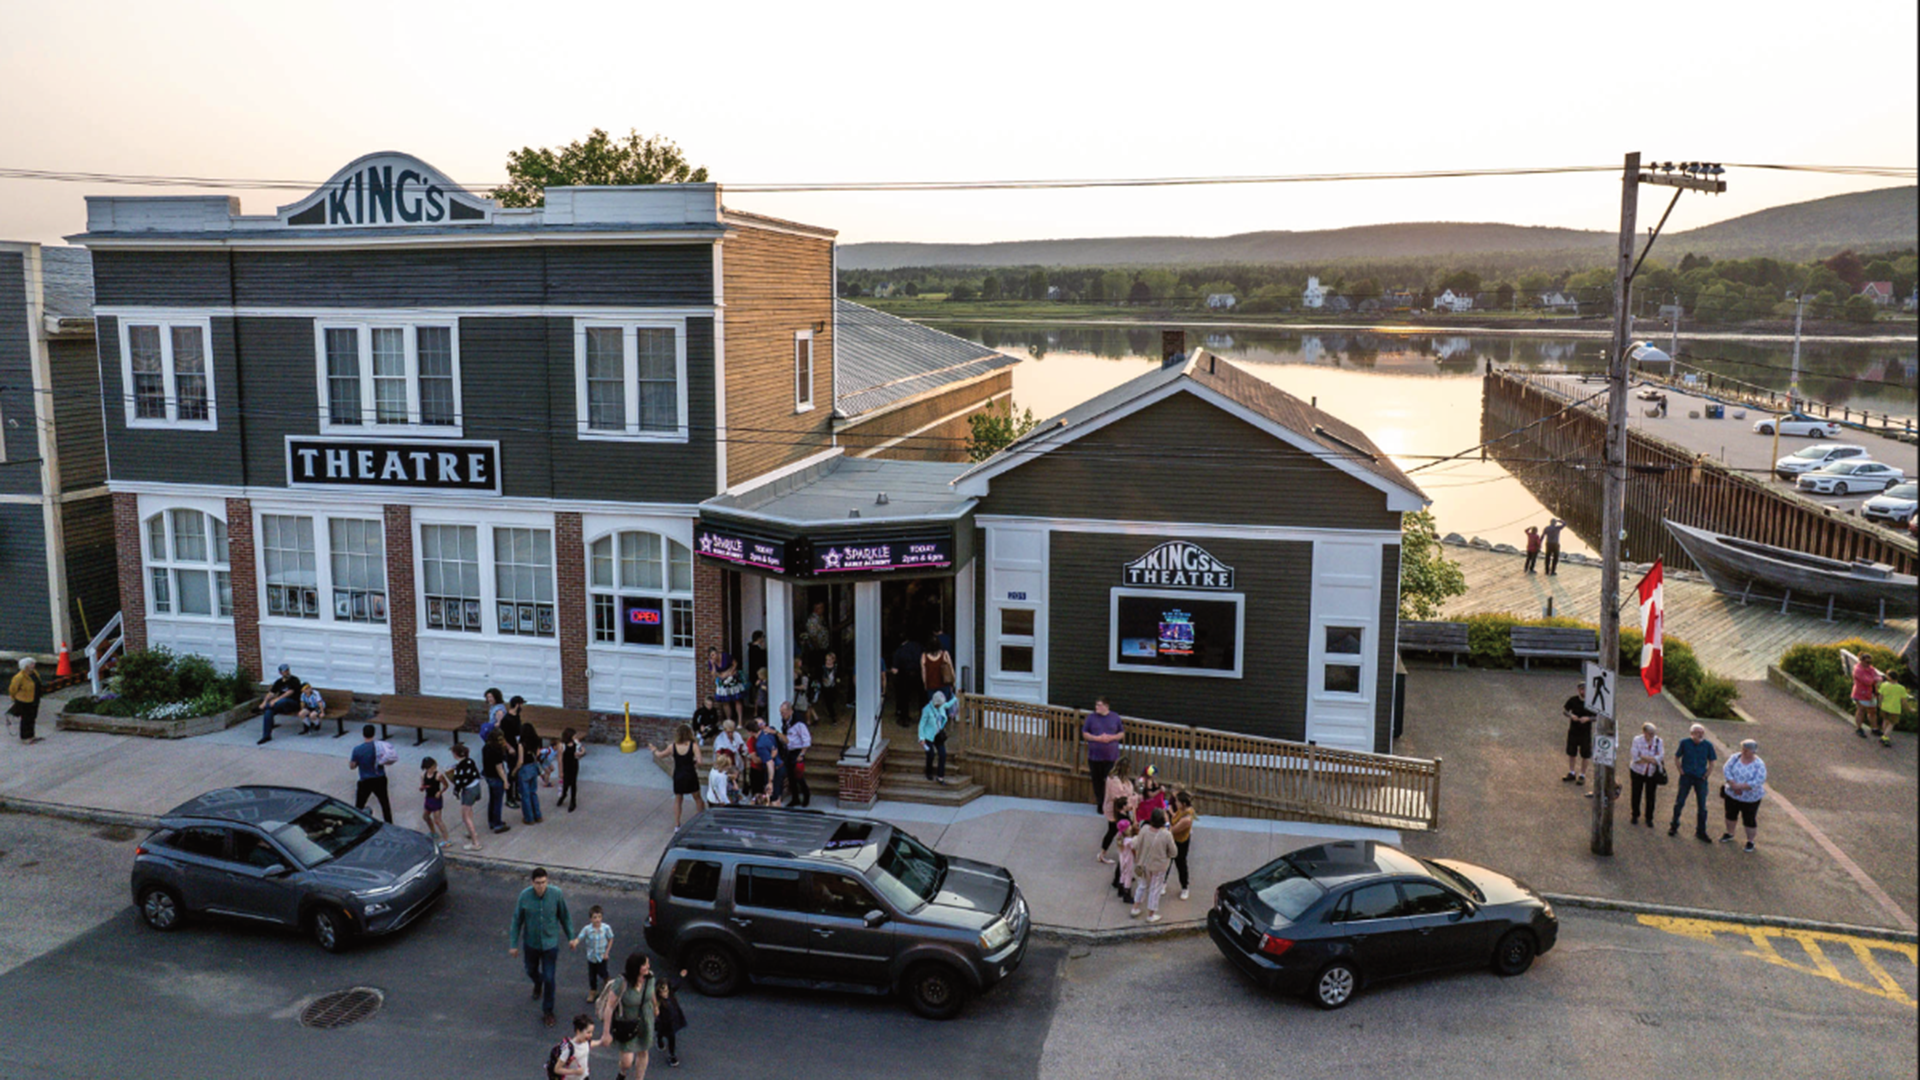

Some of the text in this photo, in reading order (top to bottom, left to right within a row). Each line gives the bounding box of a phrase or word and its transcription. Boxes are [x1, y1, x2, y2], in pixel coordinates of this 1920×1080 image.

[298, 448, 487, 483] THEATRE
[843, 545, 891, 560] SPARKLE
[909, 544, 936, 553] TODAY
[902, 554, 919, 564] 2pm
[927, 553, 944, 563] 6pm
[1129, 569, 1229, 587] THEATRE
[632, 611, 659, 623] OPEN
